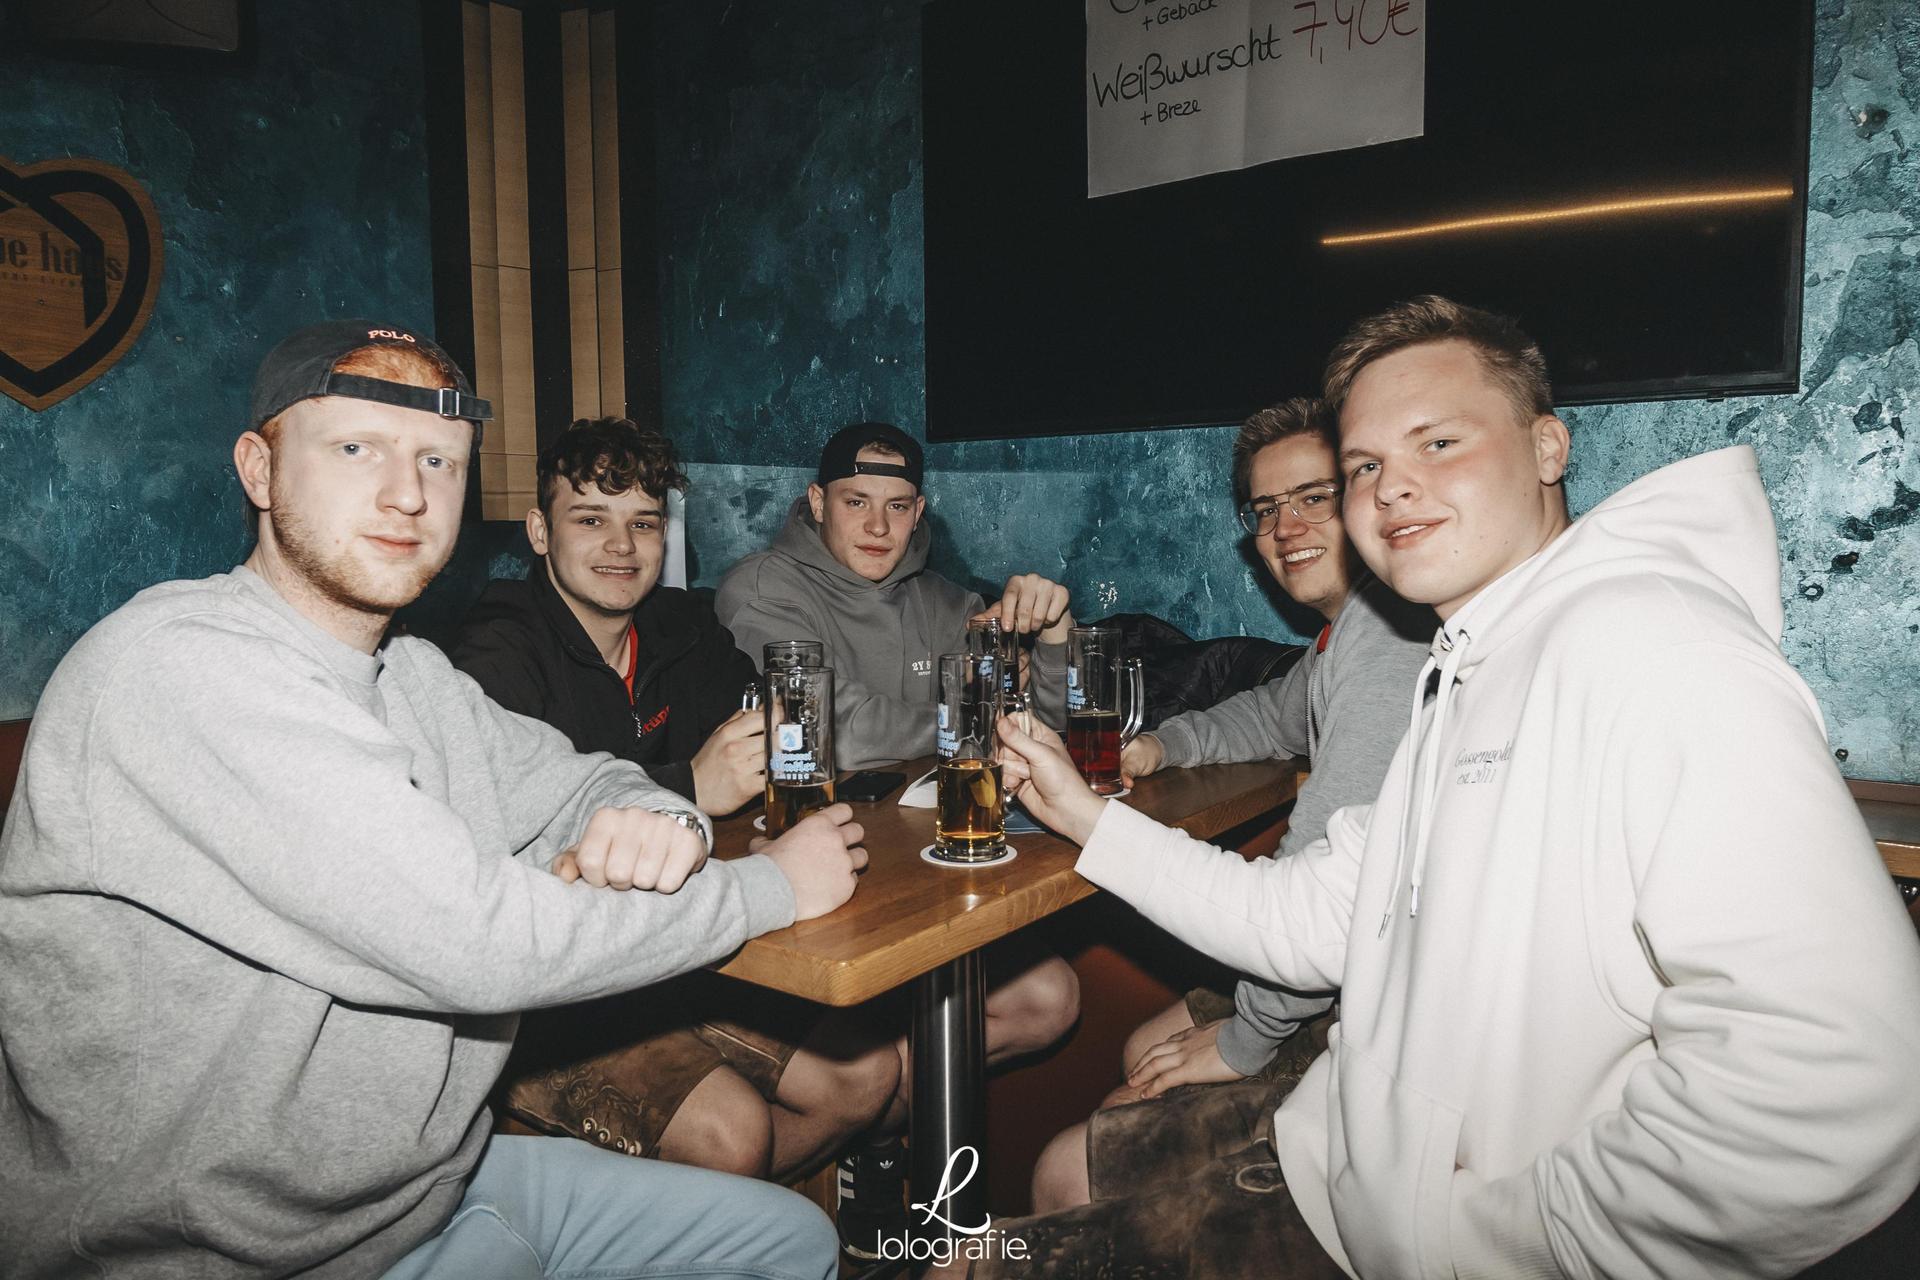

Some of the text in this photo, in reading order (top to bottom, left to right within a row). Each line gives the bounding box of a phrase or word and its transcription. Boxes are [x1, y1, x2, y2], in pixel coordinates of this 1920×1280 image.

[1093, 24, 1282, 108] Weißwurscht
[1157, 99, 1201, 123] Breze
[367, 329, 417, 343] POLO
